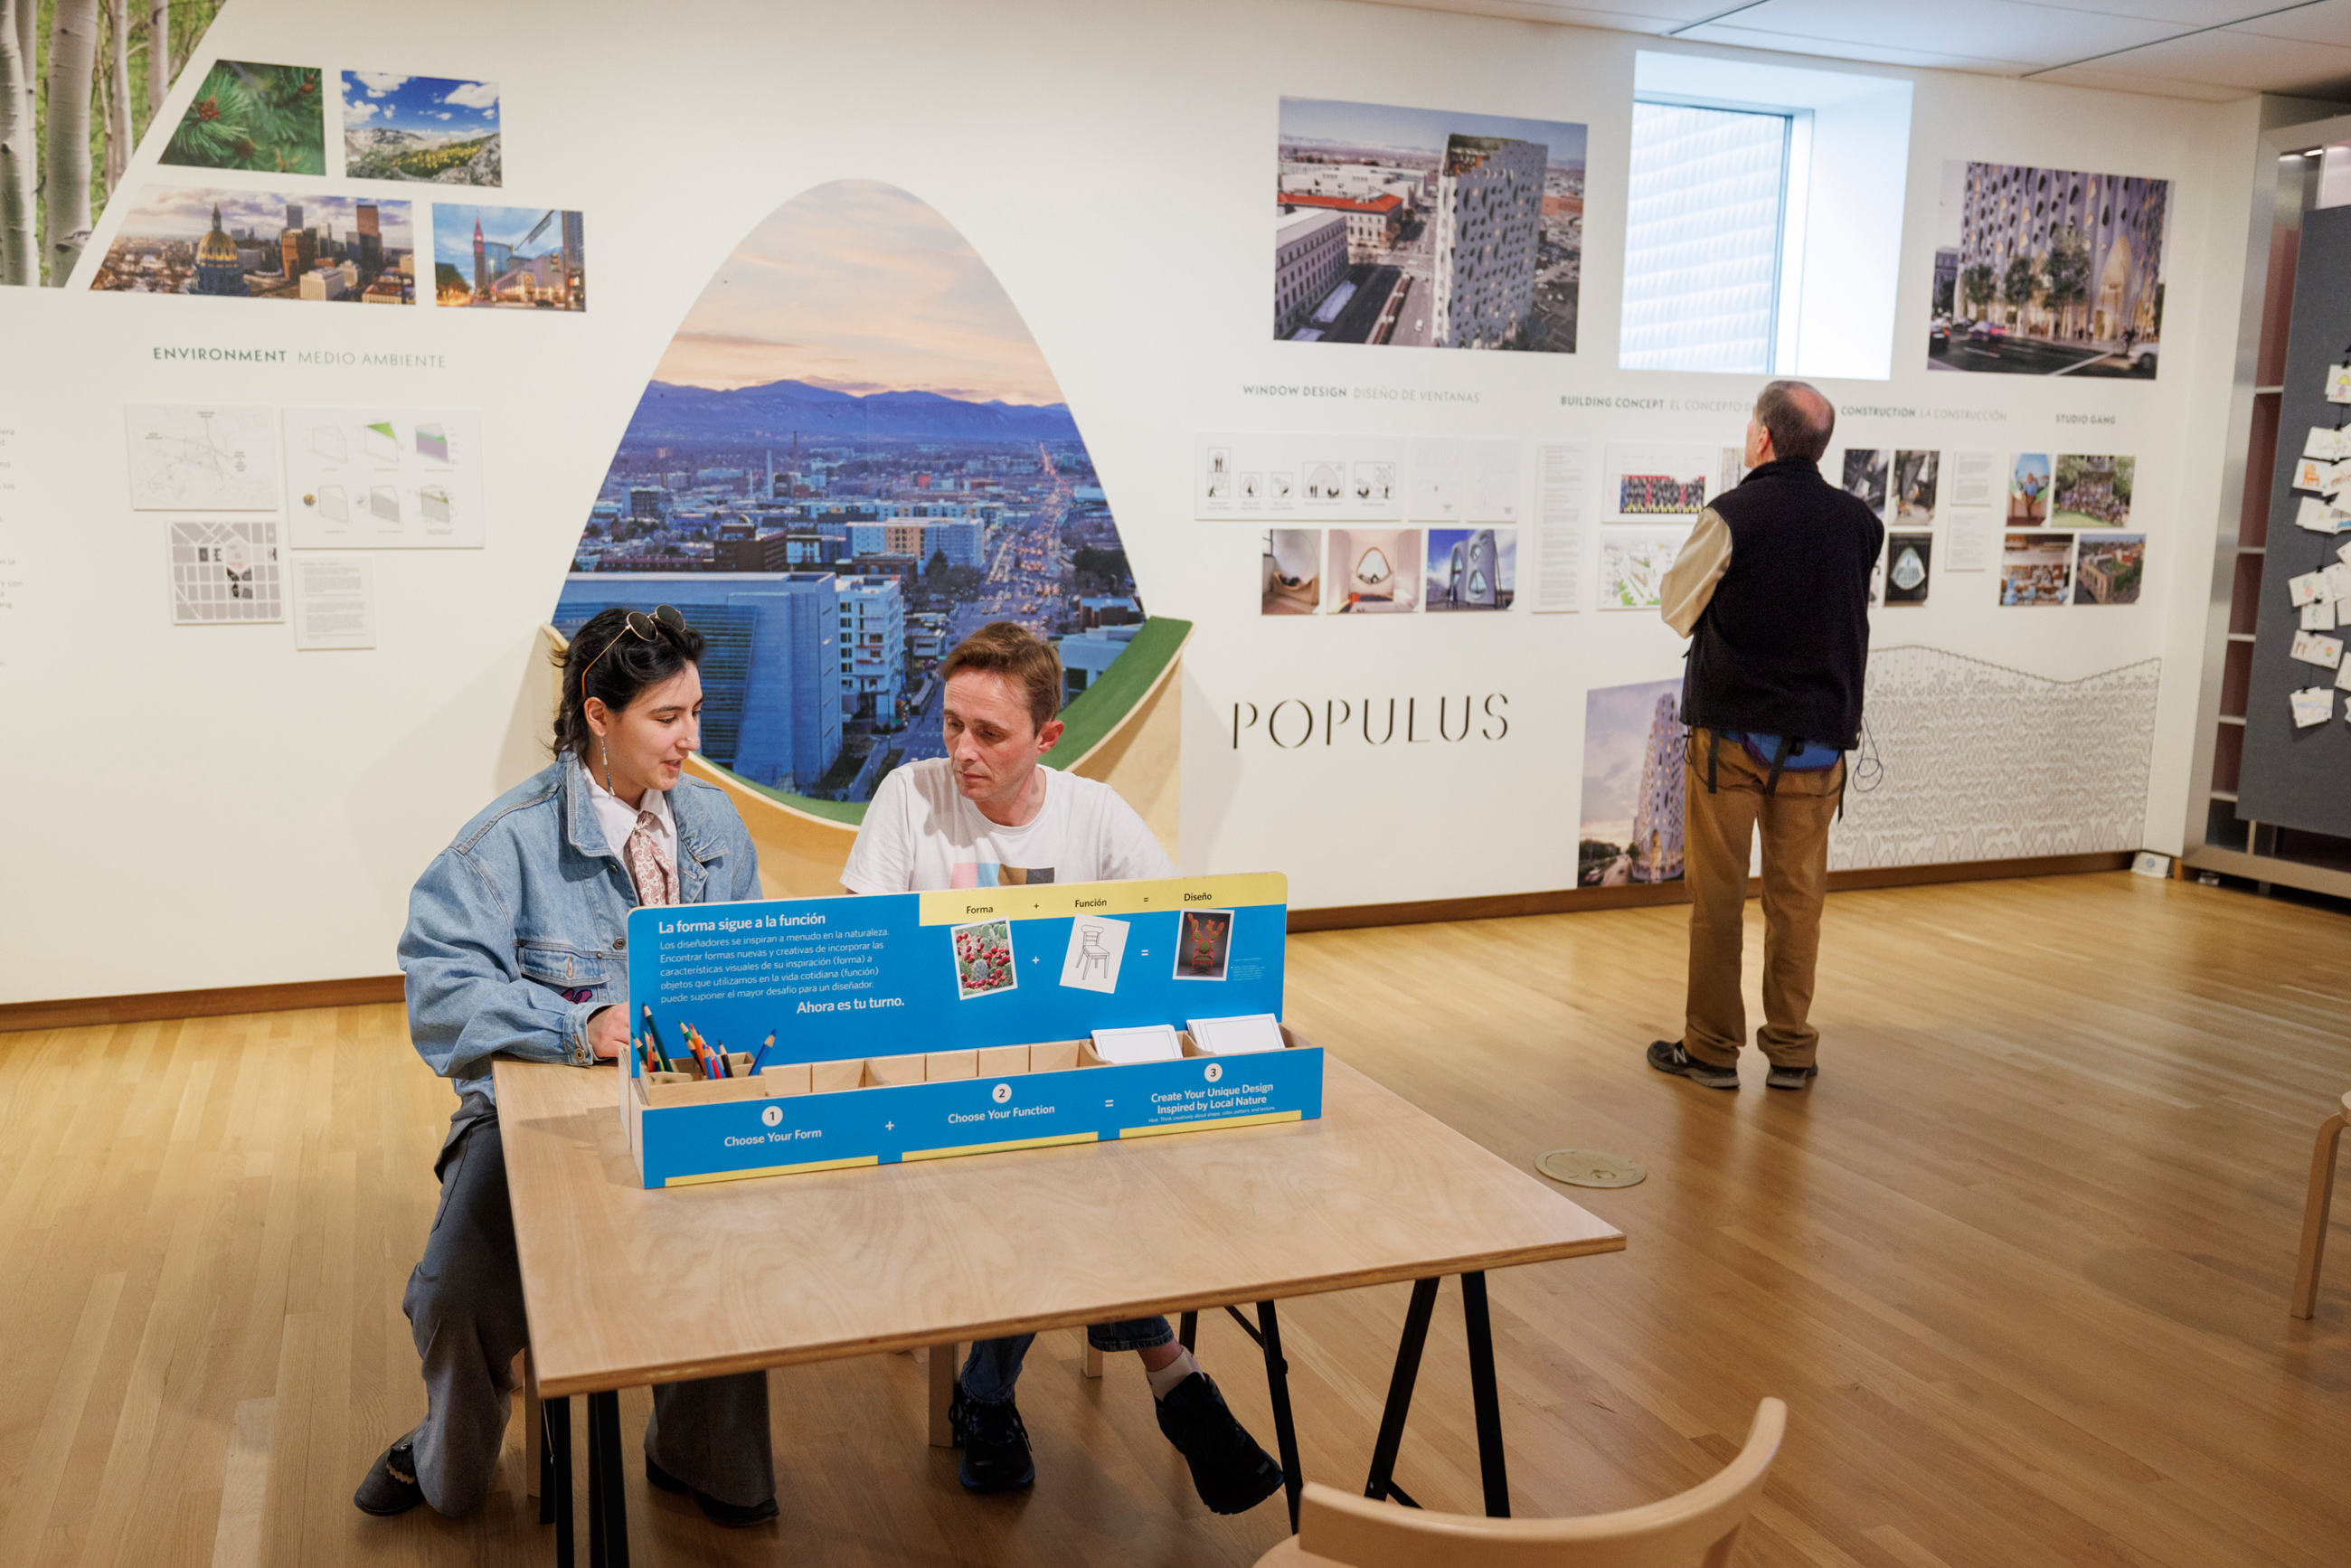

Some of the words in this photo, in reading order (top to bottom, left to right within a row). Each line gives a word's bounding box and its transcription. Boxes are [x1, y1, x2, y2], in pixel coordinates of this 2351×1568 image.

[154, 347, 287, 362] ENVIRONMENT
[297, 351, 355, 364] MEDIO
[362, 354, 447, 368] AMBIENTE
[1243, 385, 1299, 396] WINDOW
[1303, 386, 1347, 397] DESIGN
[1354, 386, 1399, 400] DISEÑO
[1402, 390, 1416, 401] DE
[1420, 391, 1480, 403] VENTANAS
[1561, 395, 1612, 407] BUILDING
[1616, 398, 1664, 409] CONCEPT
[1670, 400, 1680, 411] EL
[1685, 400, 1742, 412] CONCEPTO
[1841, 406, 1915, 417] CONSTRUCTION
[1920, 409, 1932, 419] LA
[2055, 413, 2088, 424] STUDIO
[2091, 415, 2116, 425] GANG
[1232, 693, 1508, 750] POPULUS
[966, 905, 994, 915] Forma
[1074, 898, 1107, 909] Función
[1184, 892, 1213, 902] Diseño
[658, 921, 674, 934] La
[676, 920, 715, 932] forma
[718, 917, 752, 932] sigue
[755, 919, 763, 928] a
[765, 914, 777, 928] la
[779, 912, 826, 927] función
[660, 941, 675, 950] Los
[676, 938, 730, 949] diseñadores
[732, 938, 741, 946] se
[743, 935, 778, 945] inspiran
[786, 931, 821, 941] menudo
[836, 930, 843, 939] la
[845, 928, 889, 939] naturaleza.
[660, 953, 703, 963] Encontrar
[704, 951, 735, 960] formas
[737, 949, 767, 958] nuevas
[769, 949, 774, 958] y
[776, 946, 814, 956] creativas
[816, 944, 826, 953] de
[828, 942, 870, 954] incorporar
[872, 940, 884, 949] las
[660, 965, 723, 977] características
[725, 962, 760, 972] visuales
[761, 960, 772, 970] de
[786, 957, 831, 968] inspiración
[833, 954, 866, 967] (forma)
[660, 980, 693, 990] objetos
[694, 979, 712, 988] que
[713, 977, 758, 987] utilizamos
[772, 973, 779, 982] la
[781, 972, 799, 981] vida
[800, 969, 839, 979] cotidiana
[841, 966, 879, 979] (función)
[661, 993, 688, 1005] puede
[690, 992, 725, 1002] suponer
[727, 989, 735, 998] el
[737, 989, 764, 998] mayor
[766, 985, 798, 996] desafío
[798, 985, 817, 995] para
[819, 984, 830, 992] un
[832, 979, 873, 991] diseñador.
[797, 1001, 835, 1014] Ahora
[837, 1001, 852, 1011] es
[854, 998, 866, 1009] tu
[869, 997, 904, 1008] turno.
[1210, 1068, 1217, 1078] 3
[998, 1089, 1006, 1099] 2
[1151, 1091, 1182, 1103] Create
[1185, 1089, 1205, 1100] Your
[1207, 1086, 1240, 1099] Unique
[1242, 1083, 1274, 1095] Design
[948, 1112, 986, 1124] Choose
[987, 1110, 1011, 1119] Your
[1013, 1104, 1055, 1117] Function
[1157, 1101, 1195, 1115] Inspired
[1197, 1100, 1209, 1112] by
[1210, 1097, 1233, 1109] Local
[1236, 1094, 1268, 1106] Nature
[770, 1110, 776, 1121] 1
[724, 1135, 765, 1147] Choose
[767, 1131, 792, 1142] Your
[795, 1129, 822, 1139] Form
